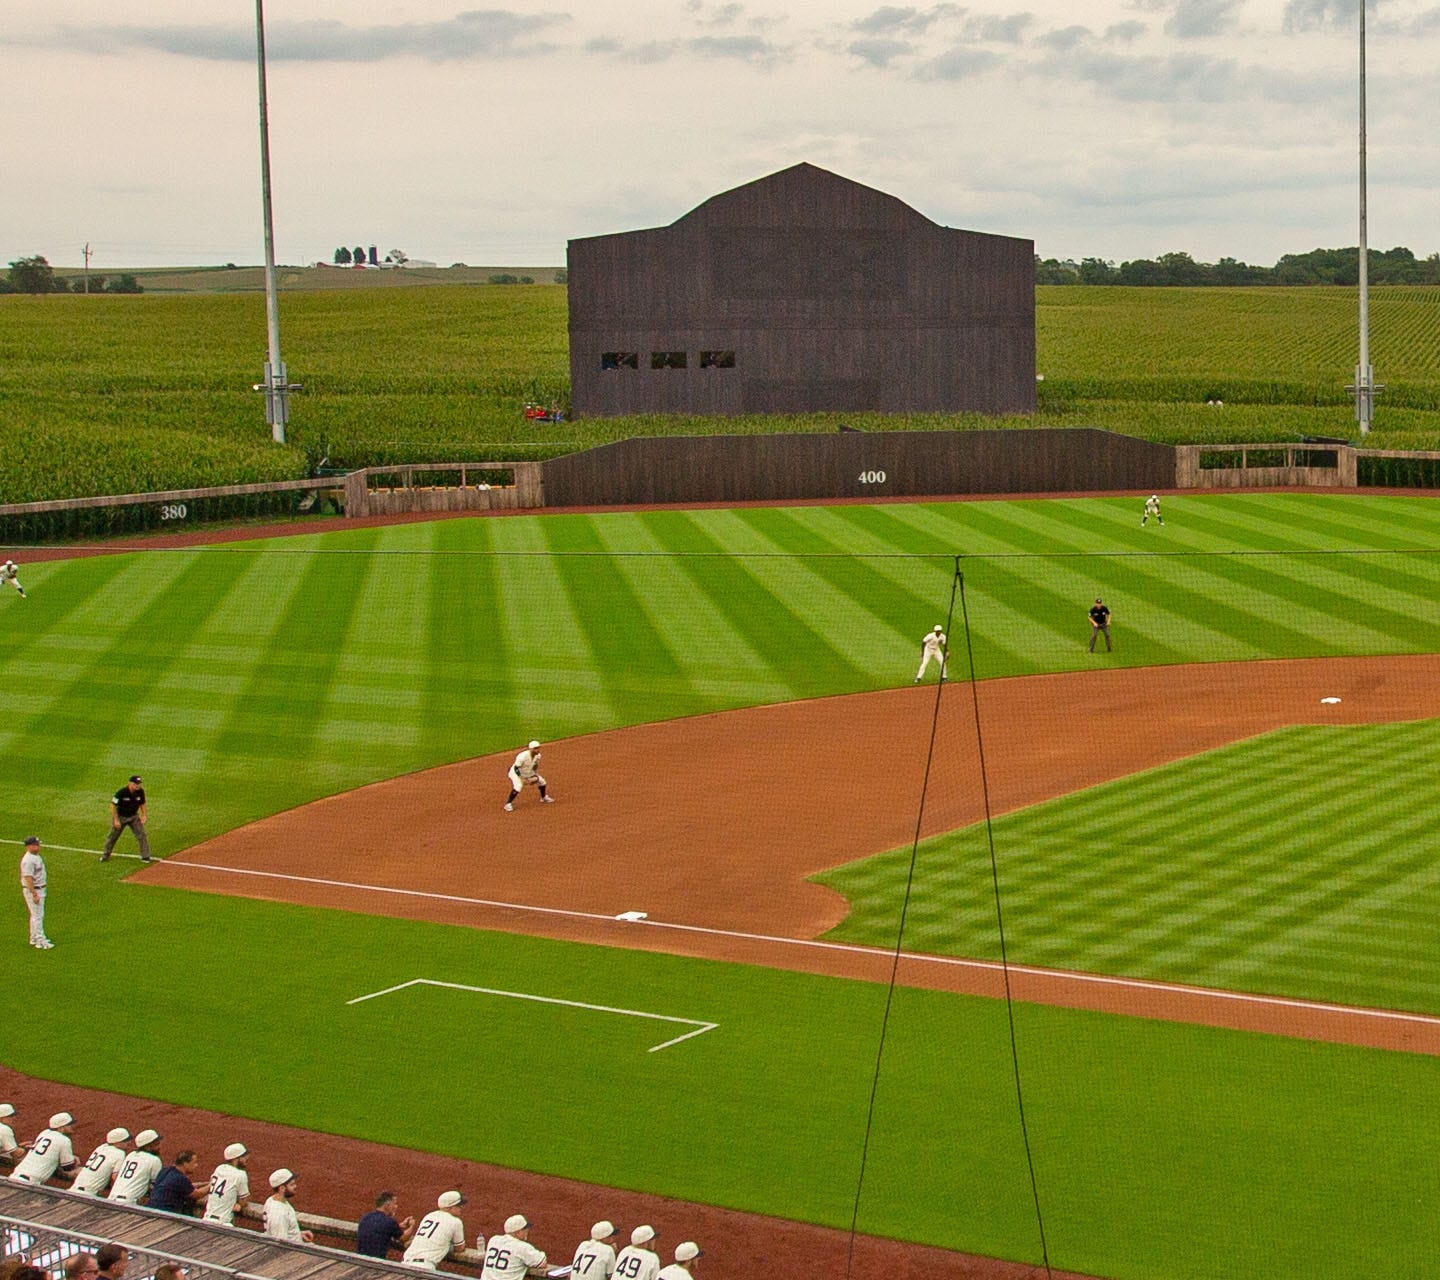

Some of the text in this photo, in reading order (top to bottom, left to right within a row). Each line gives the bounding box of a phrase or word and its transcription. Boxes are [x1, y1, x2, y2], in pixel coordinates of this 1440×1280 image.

[858, 470, 886, 484] 400
[160, 504, 187, 520] 380
[85, 1152, 105, 1172] 20
[121, 1160, 138, 1179] 18
[418, 1220, 440, 1239] 21
[486, 1247, 511, 1271] 26
[572, 1253, 596, 1275] 47
[615, 1255, 641, 1279] 49
